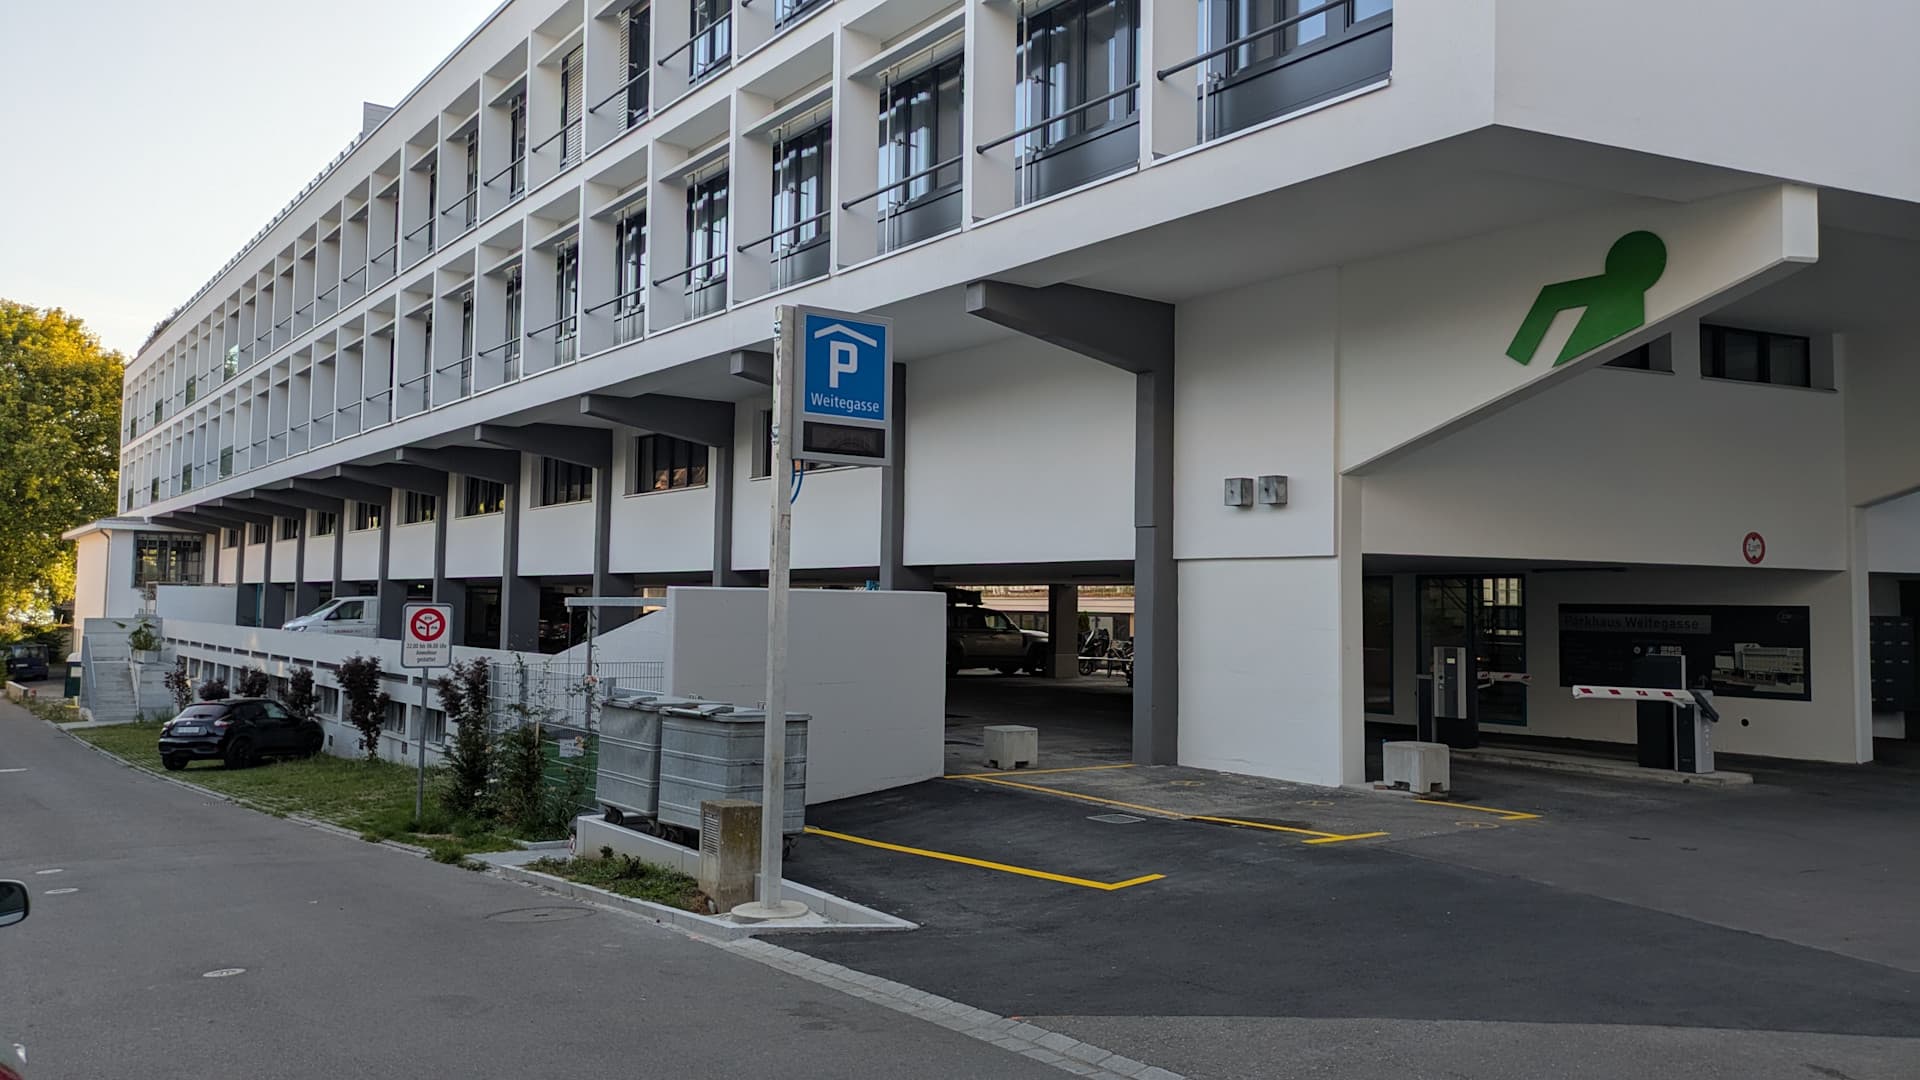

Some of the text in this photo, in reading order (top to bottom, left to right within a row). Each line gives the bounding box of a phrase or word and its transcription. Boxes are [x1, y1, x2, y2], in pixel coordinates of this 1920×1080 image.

[829, 340, 858, 388] P
[810, 392, 880, 413] Weitegasse
[1564, 615, 1699, 631] Parkhaus Weitegasse
